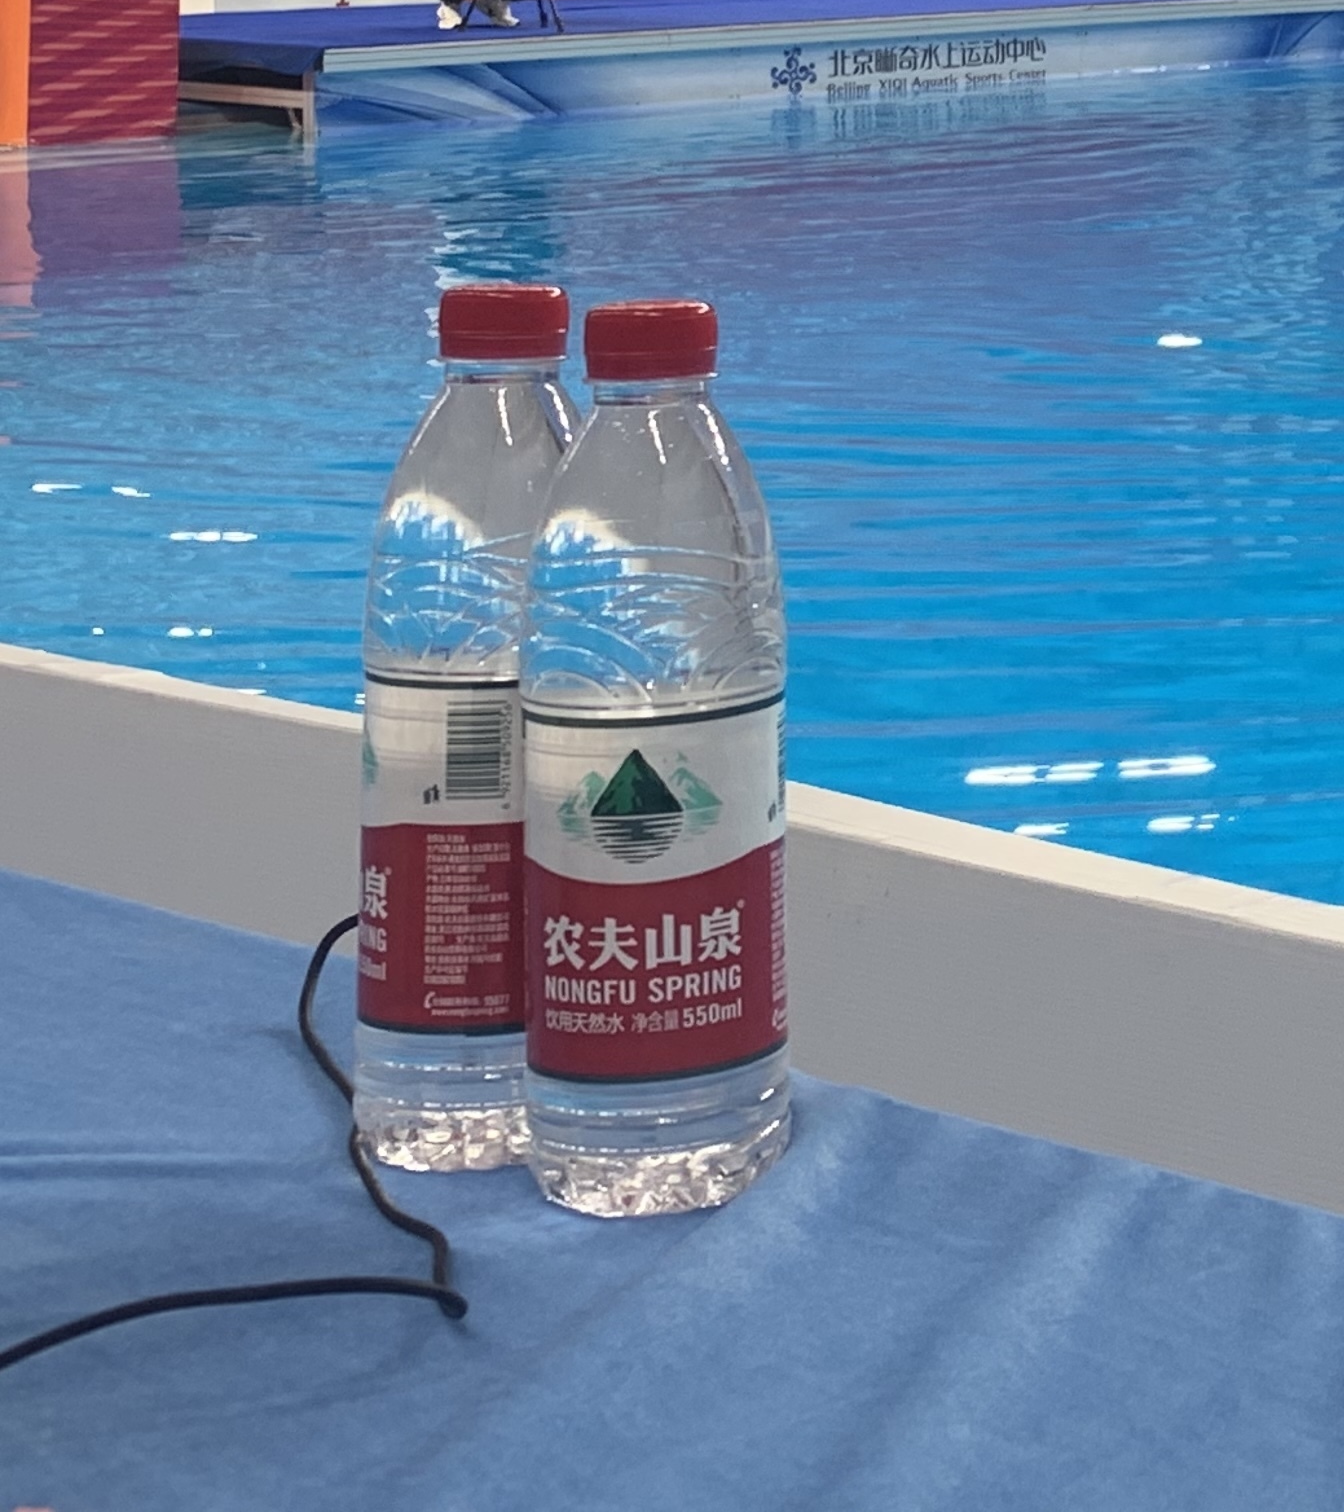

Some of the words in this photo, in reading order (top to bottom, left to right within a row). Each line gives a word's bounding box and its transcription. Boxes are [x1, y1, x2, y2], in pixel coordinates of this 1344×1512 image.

[827, 36, 1047, 78] 北京晰奇水上运动中心
[543, 906, 742, 972] 农夫山泉
[545, 975, 636, 1005] NONGFU
[647, 964, 742, 1004] SPRING
[545, 1008, 625, 1034] 饮用天然水
